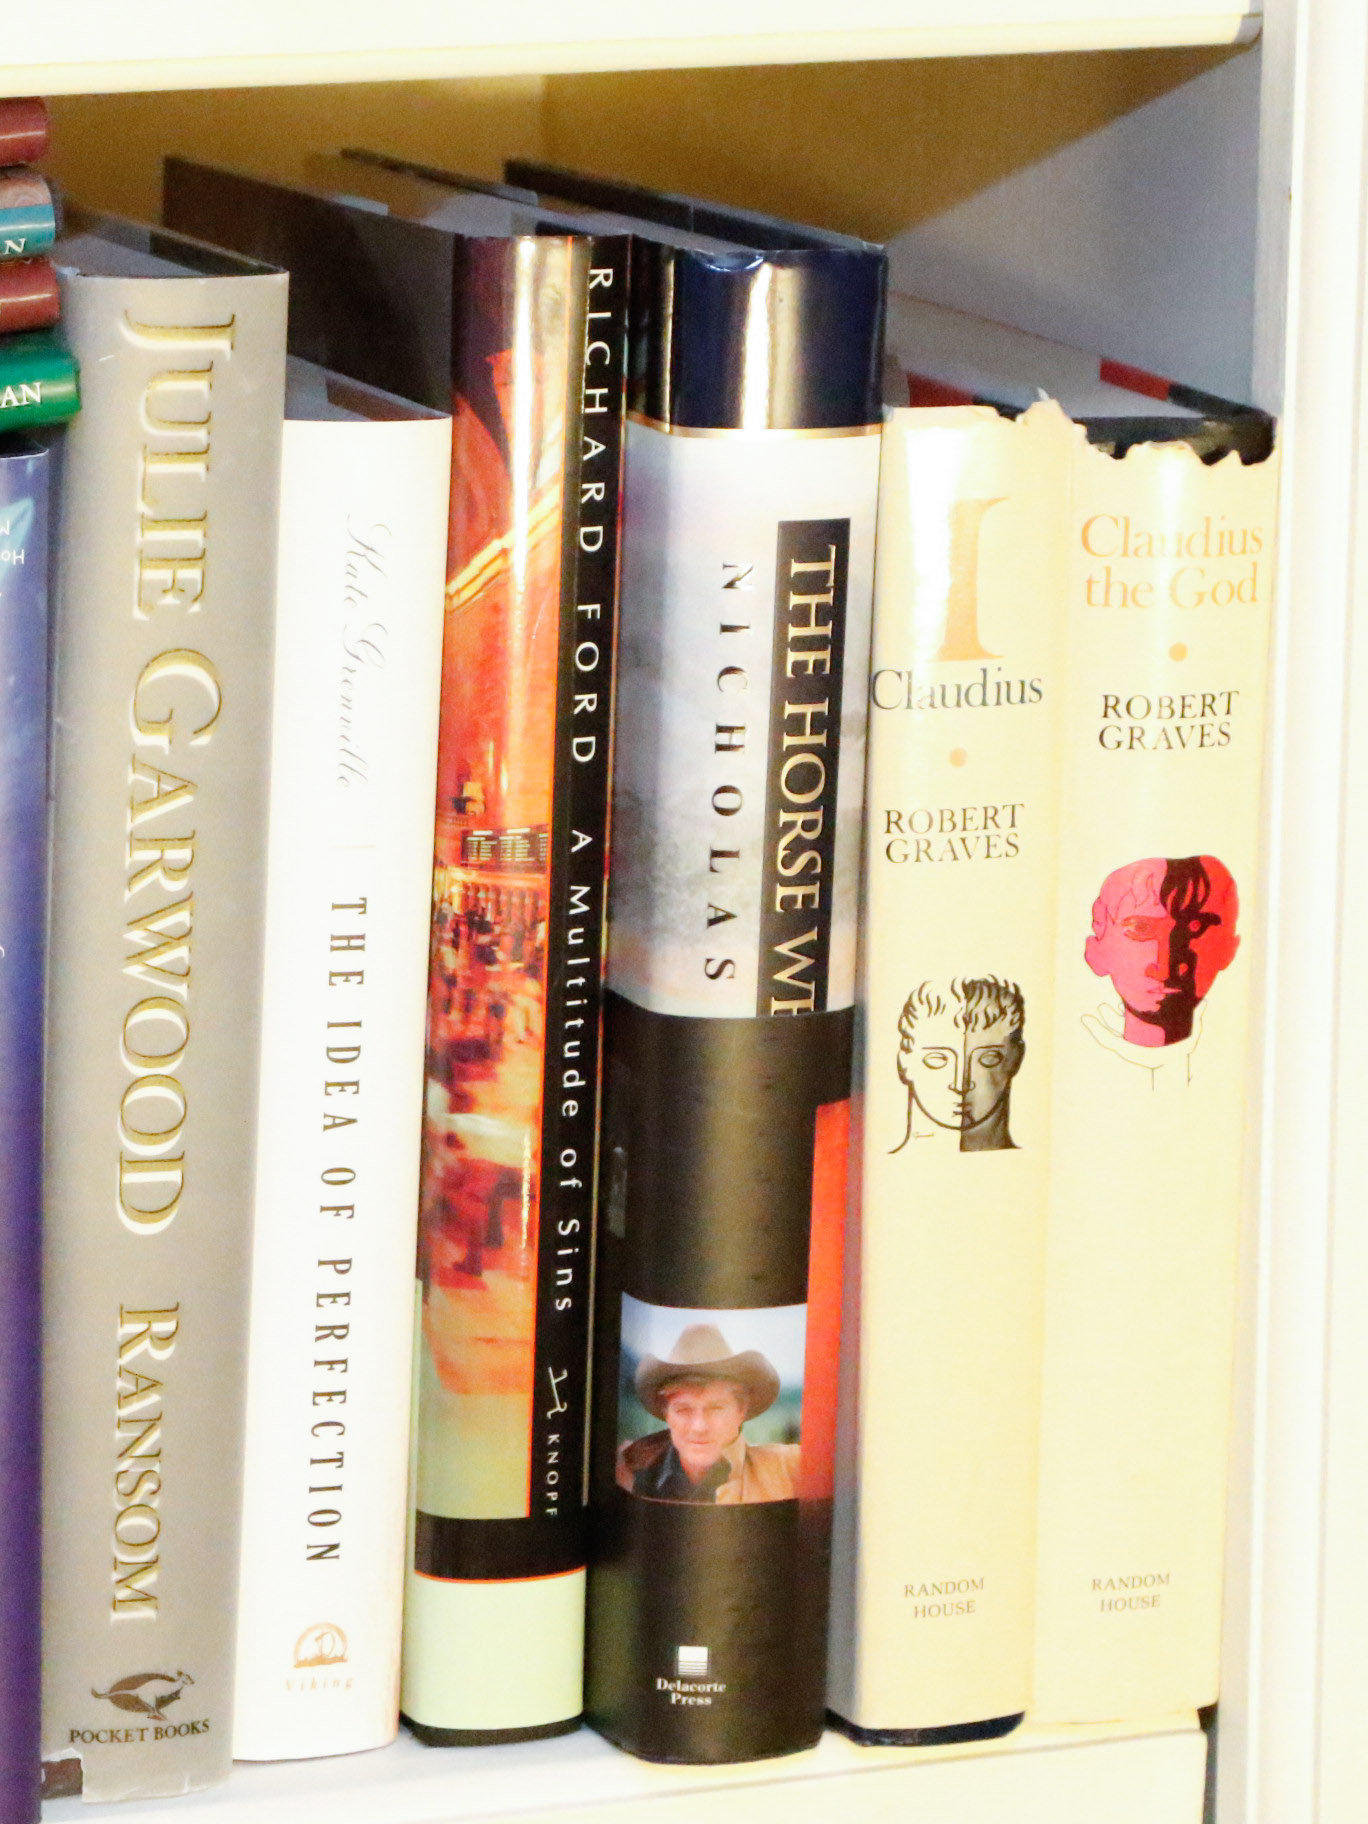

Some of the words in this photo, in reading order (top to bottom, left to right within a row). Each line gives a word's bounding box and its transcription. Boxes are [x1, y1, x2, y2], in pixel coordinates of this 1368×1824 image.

[578, 267, 614, 553] RICHARD
[120, 310, 235, 620] JULIE
[1081, 514, 1263, 559] Claudius
[927, 496, 1011, 663] I
[1084, 566, 1153, 609] the
[1168, 562, 1258, 609] God
[787, 544, 836, 680] THE
[572, 604, 601, 764] FORD
[872, 666, 1044, 710] Claudius
[1102, 690, 1239, 720] ROBERT
[1098, 722, 1232, 751] GRAVES
[704, 559, 755, 983] NICHOLAS
[775, 700, 830, 913] HORSE
[884, 804, 1024, 836] ROBERT
[570, 830, 593, 853] A
[885, 832, 1020, 864] GRAVES
[116, 647, 223, 1236] GARWOOD
[329, 896, 368, 986] THE
[561, 884, 593, 1118] Multitude
[322, 1020, 362, 1133] IDEA
[561, 1147, 581, 1190] of
[319, 1166, 357, 1221] OF
[555, 1216, 581, 1312] Sins
[305, 1257, 352, 1564] PERFECTION
[110, 1300, 180, 1625] RANSOM
[546, 1435, 561, 1518] KNOPF
[903, 1578, 985, 1599] RANDOM
[1091, 1573, 1171, 1594] RANDOM
[1100, 1594, 1162, 1613] HOUSE
[914, 1600, 976, 1619] HOUSE
[285, 1677, 354, 1691] Viking
[656, 1677, 727, 1694] Delacorte
[669, 1691, 712, 1707] Press
[70, 1728, 149, 1744] POCKET
[154, 1718, 210, 1741] BOOKS
